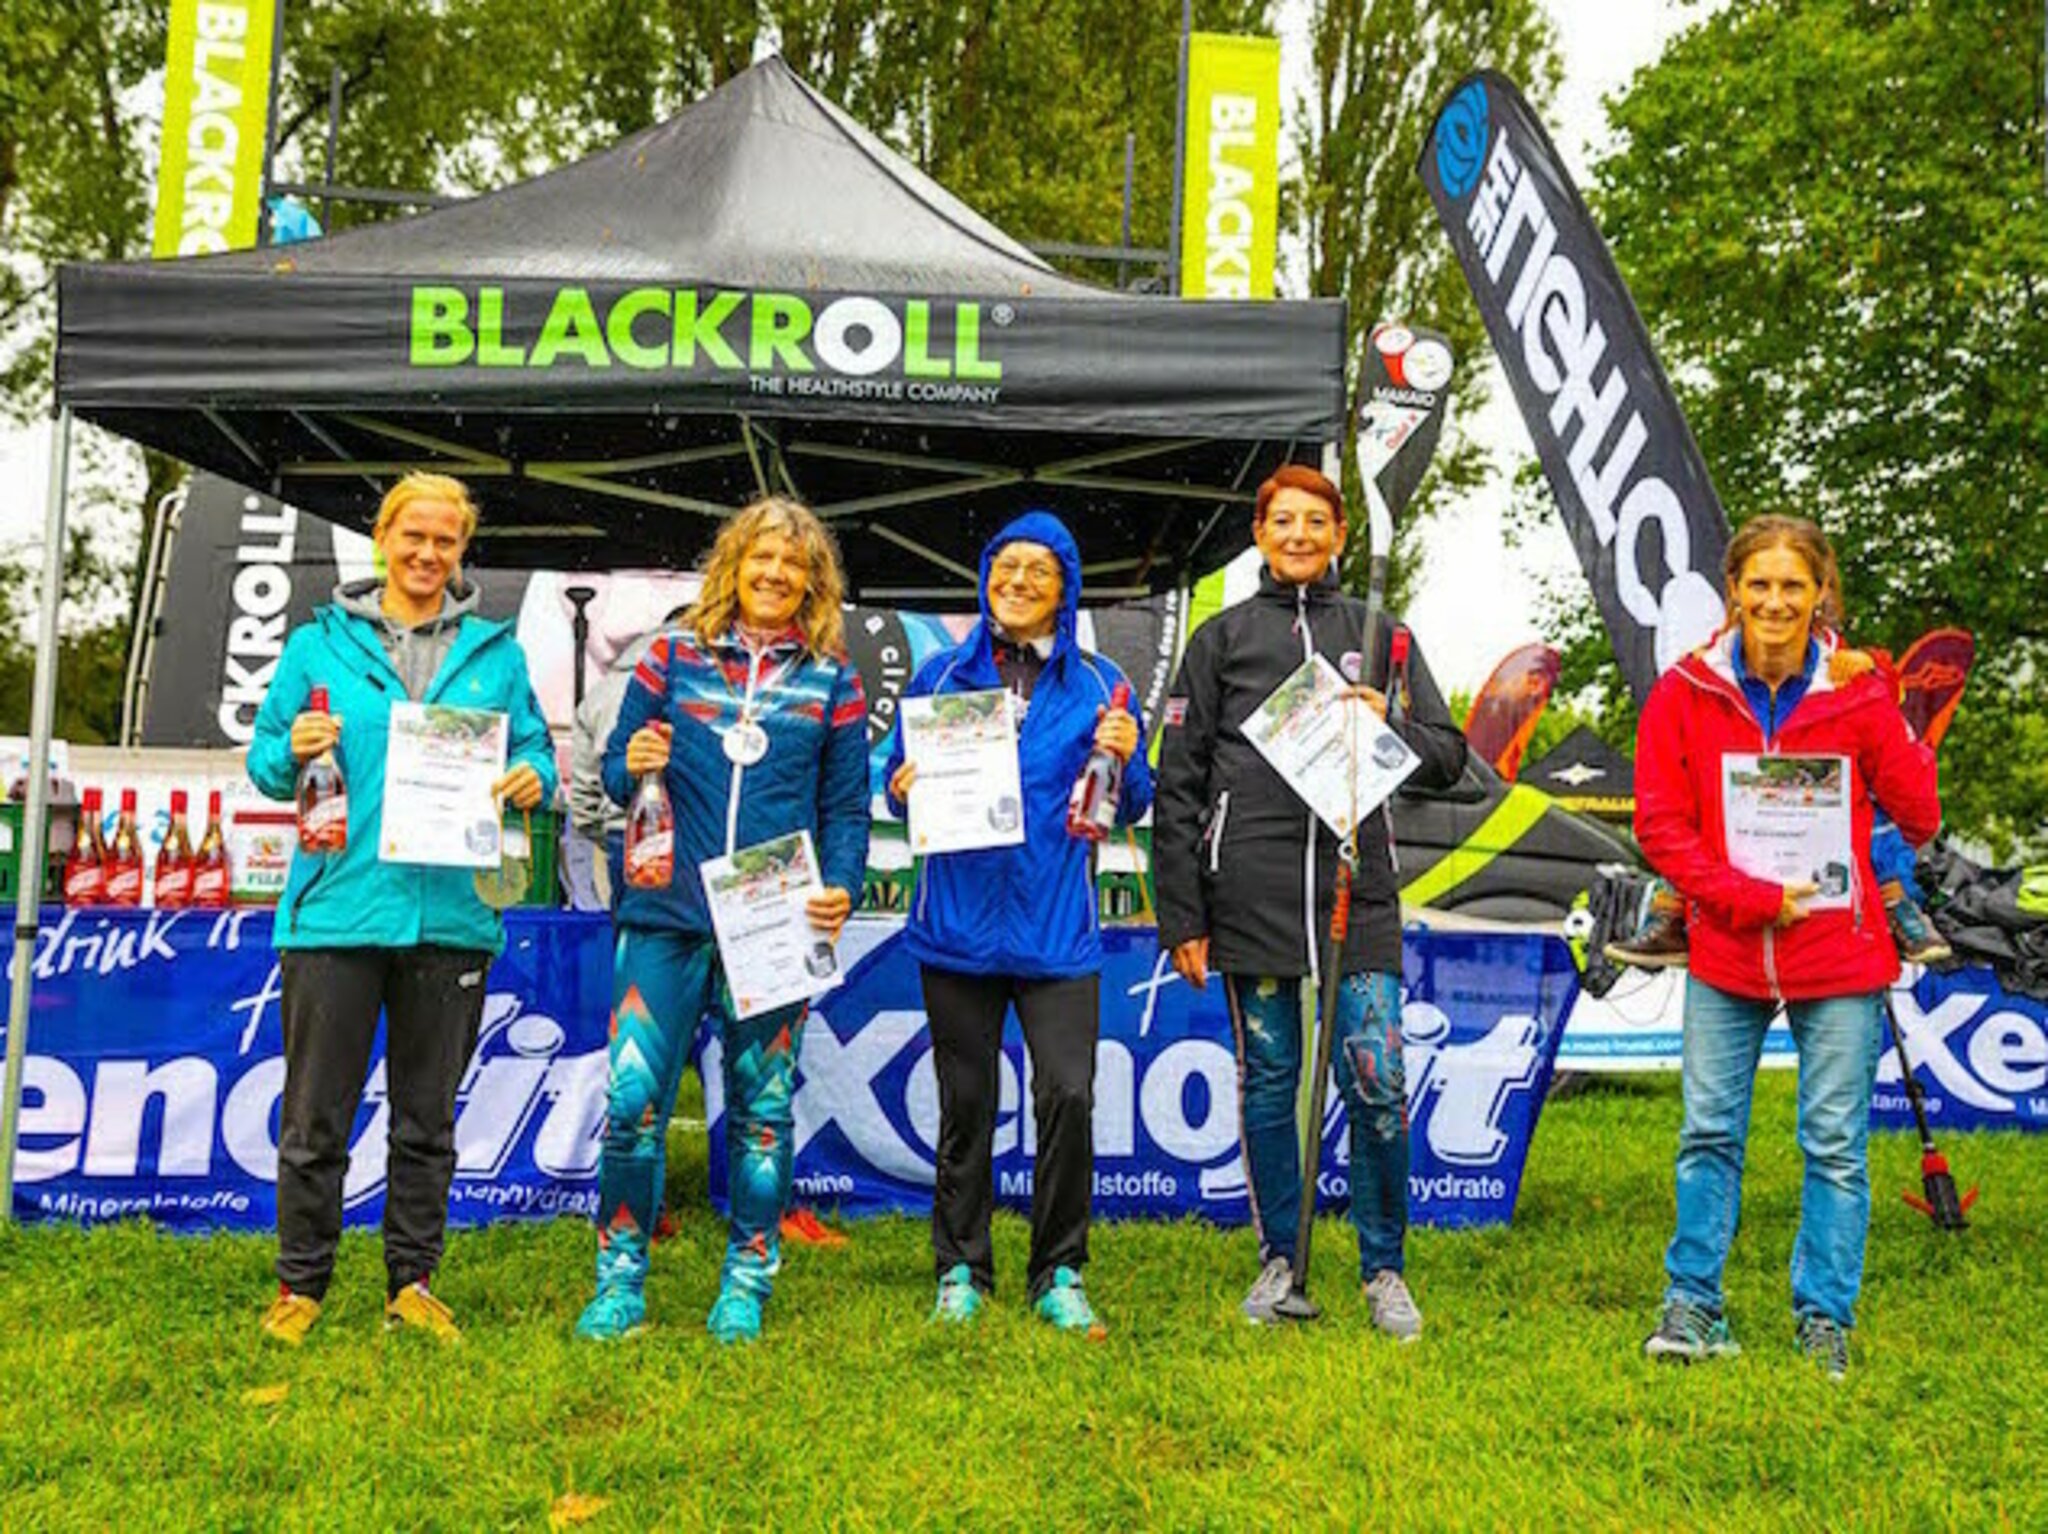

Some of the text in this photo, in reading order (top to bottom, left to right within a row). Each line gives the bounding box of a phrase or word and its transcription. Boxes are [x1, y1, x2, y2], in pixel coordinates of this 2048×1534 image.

[409, 286, 1002, 378] BLACKROLL
[750, 374, 1000, 403] THE HEALTHSTYLE COMPANY
[217, 503, 298, 751] CKROLL
